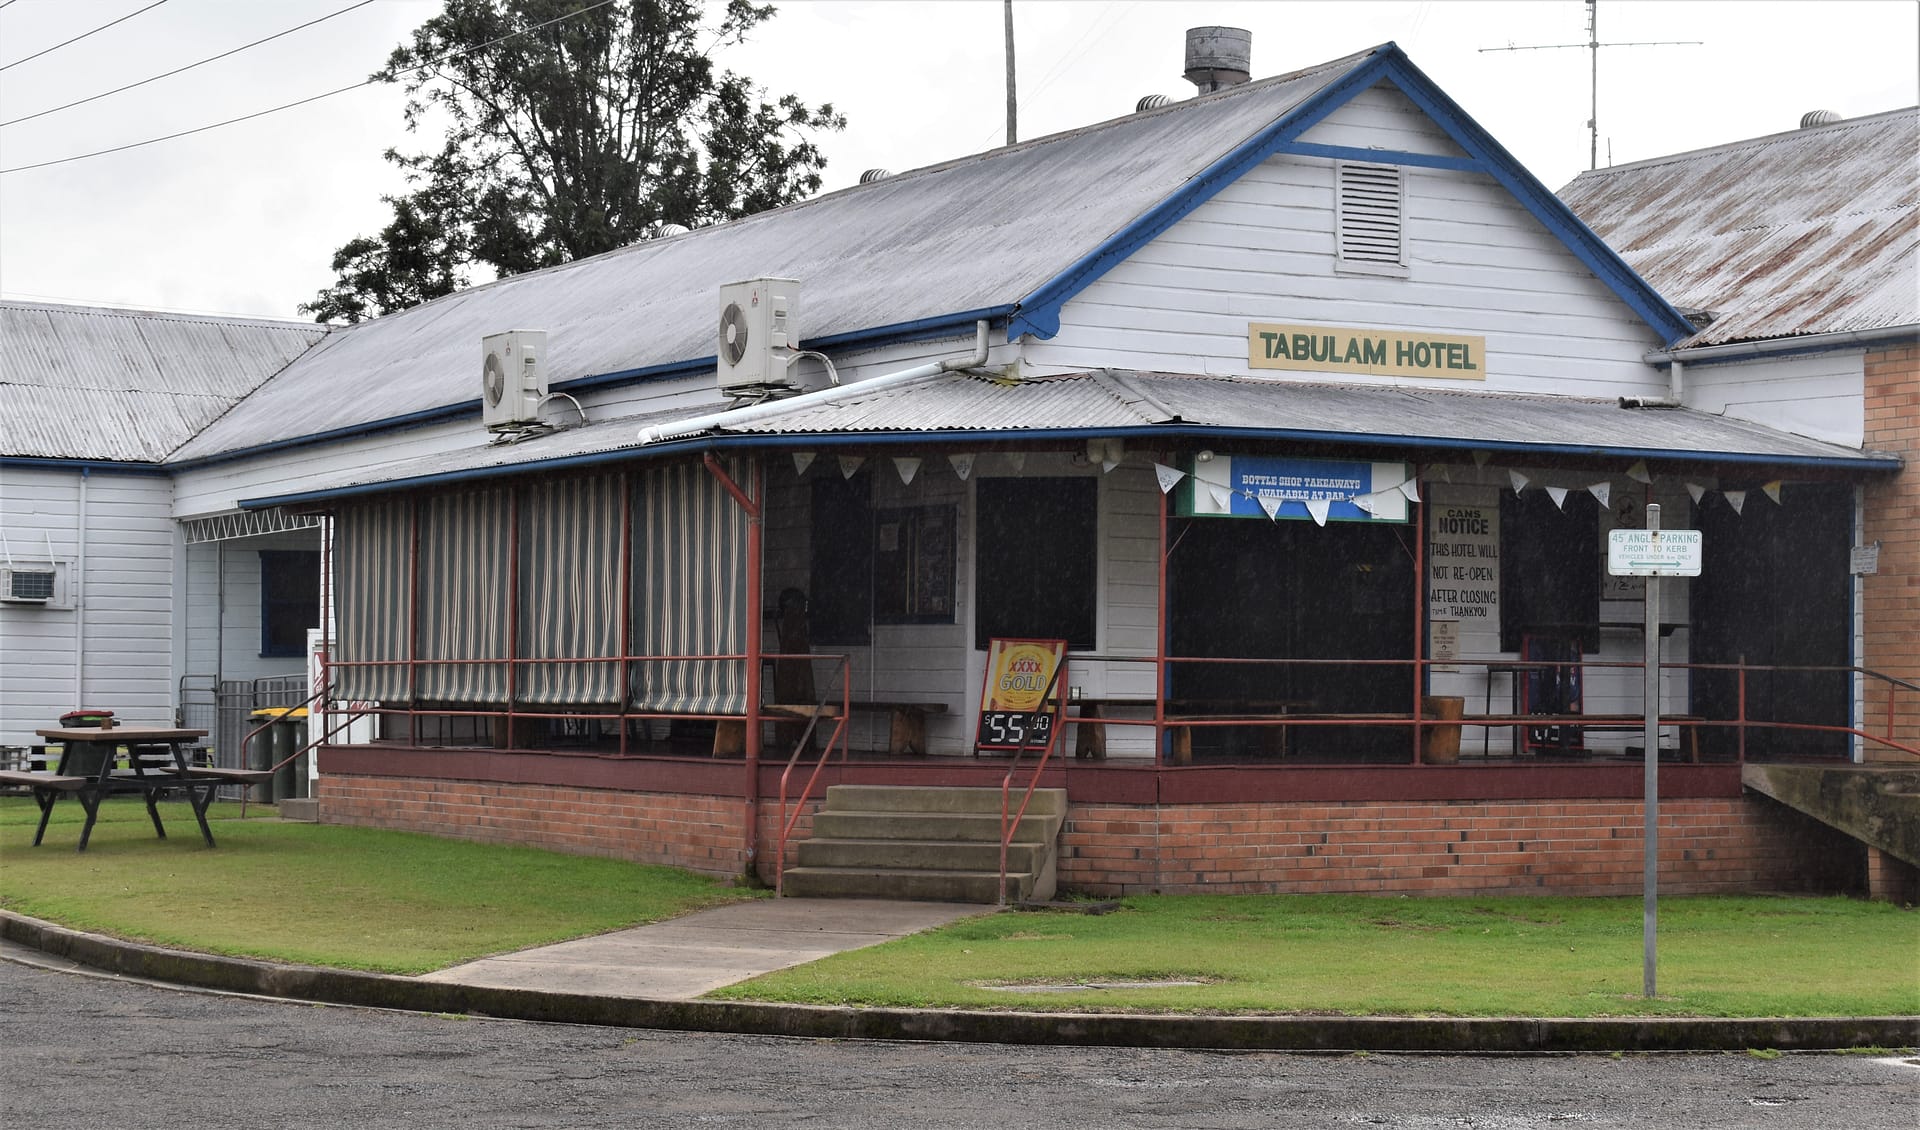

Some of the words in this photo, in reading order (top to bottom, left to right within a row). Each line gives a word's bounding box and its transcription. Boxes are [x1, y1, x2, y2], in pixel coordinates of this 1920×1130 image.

[1259, 331, 1387, 366] TABULAM
[1396, 340, 1477, 370] HOTEL
[1241, 474, 1278, 486] BOTTLE
[1279, 476, 1302, 487] SHOP
[1304, 478, 1361, 489] TAKEAWAYS
[1258, 488, 1309, 500] AVAILABLE
[1311, 490, 1324, 500] AT
[1326, 491, 1345, 501] BAR
[1447, 509, 1481, 519] CANS
[1439, 517, 1489, 535] NOTICE
[1612, 533, 1624, 543] 45
[1628, 533, 1657, 543] ANGLE
[1660, 534, 1698, 544] PARKING
[1430, 542, 1450, 557] THIS
[1451, 543, 1477, 558] HOTEL
[1478, 543, 1498, 558] WILL
[1623, 544, 1649, 552] FRONT
[1666, 545, 1688, 553] KERB
[1432, 566, 1449, 580] NOT
[1453, 566, 1494, 581] RE-OPEN
[1430, 589, 1458, 603] AFTER
[1460, 590, 1496, 605] CLOSING
[1450, 605, 1488, 618] THANKYOU
[1008, 661, 1042, 673] XXXX
[1000, 673, 1047, 692] GOLD
